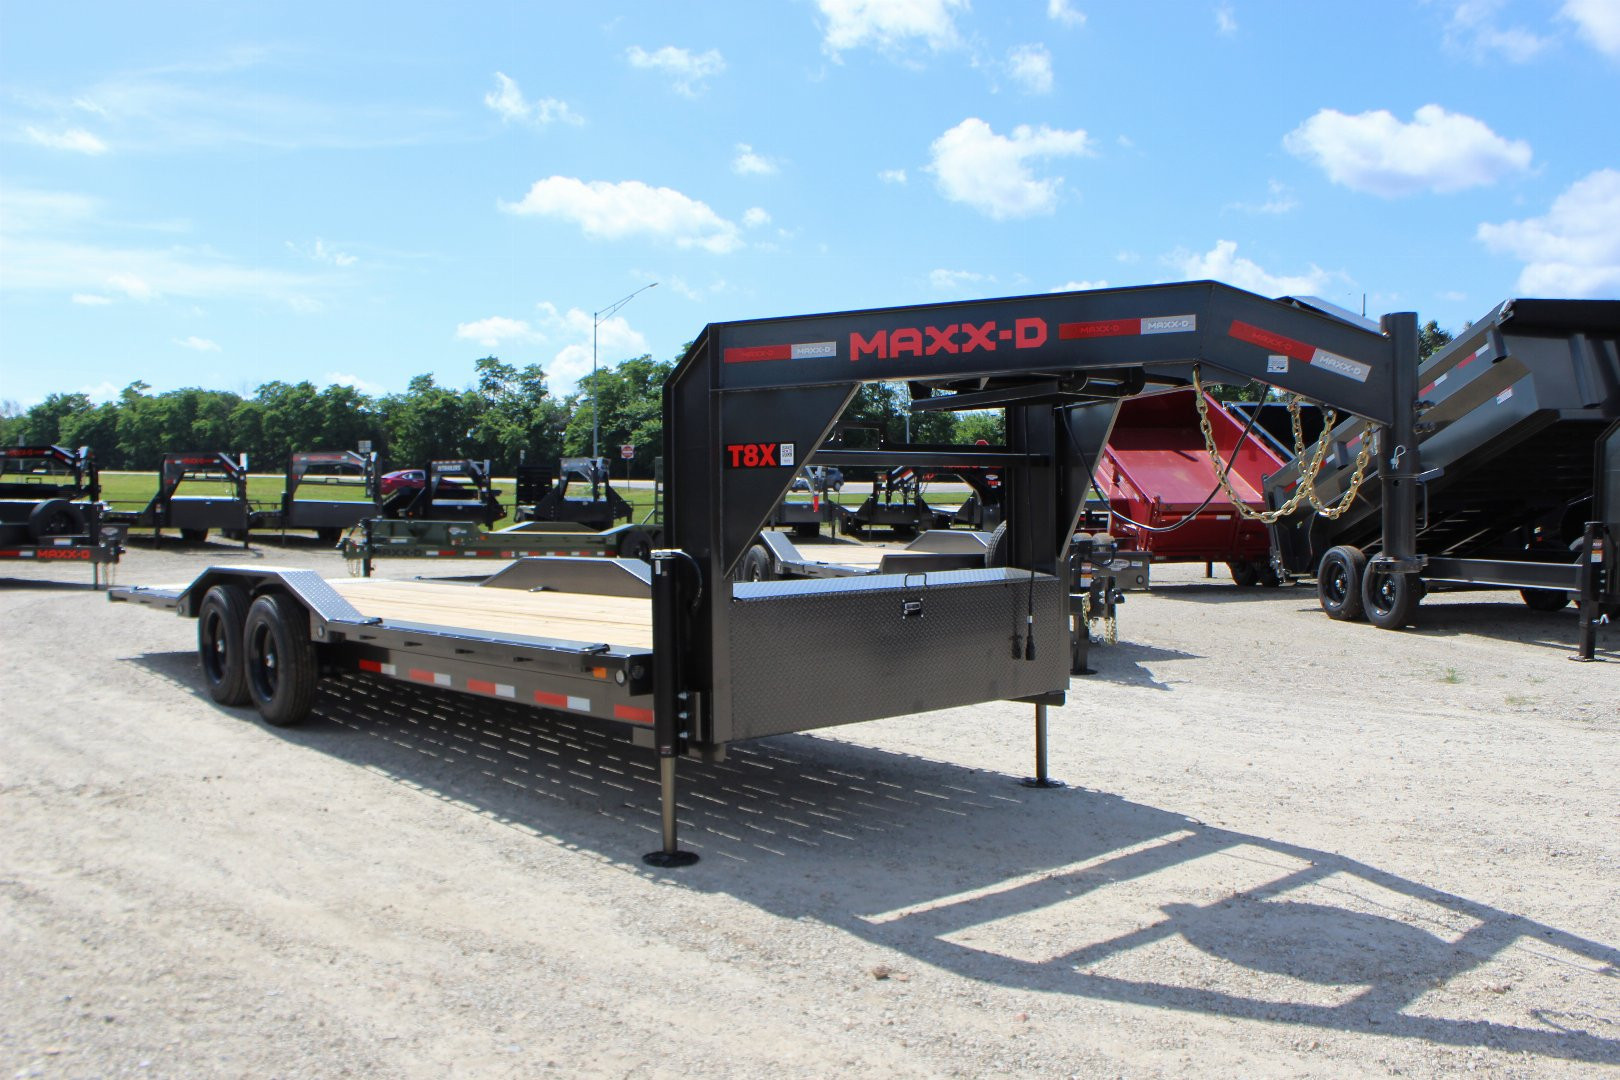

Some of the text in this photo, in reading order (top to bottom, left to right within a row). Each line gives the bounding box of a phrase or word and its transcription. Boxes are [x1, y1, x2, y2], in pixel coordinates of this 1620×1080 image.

[1147, 320, 1189, 330] MAXX-D
[849, 317, 1048, 361] MAXX-D
[797, 346, 831, 355] MAXX-D
[1319, 355, 1361, 375] MAXX-D
[727, 443, 777, 467] T8X
[36, 548, 91, 560] MAXX-D
